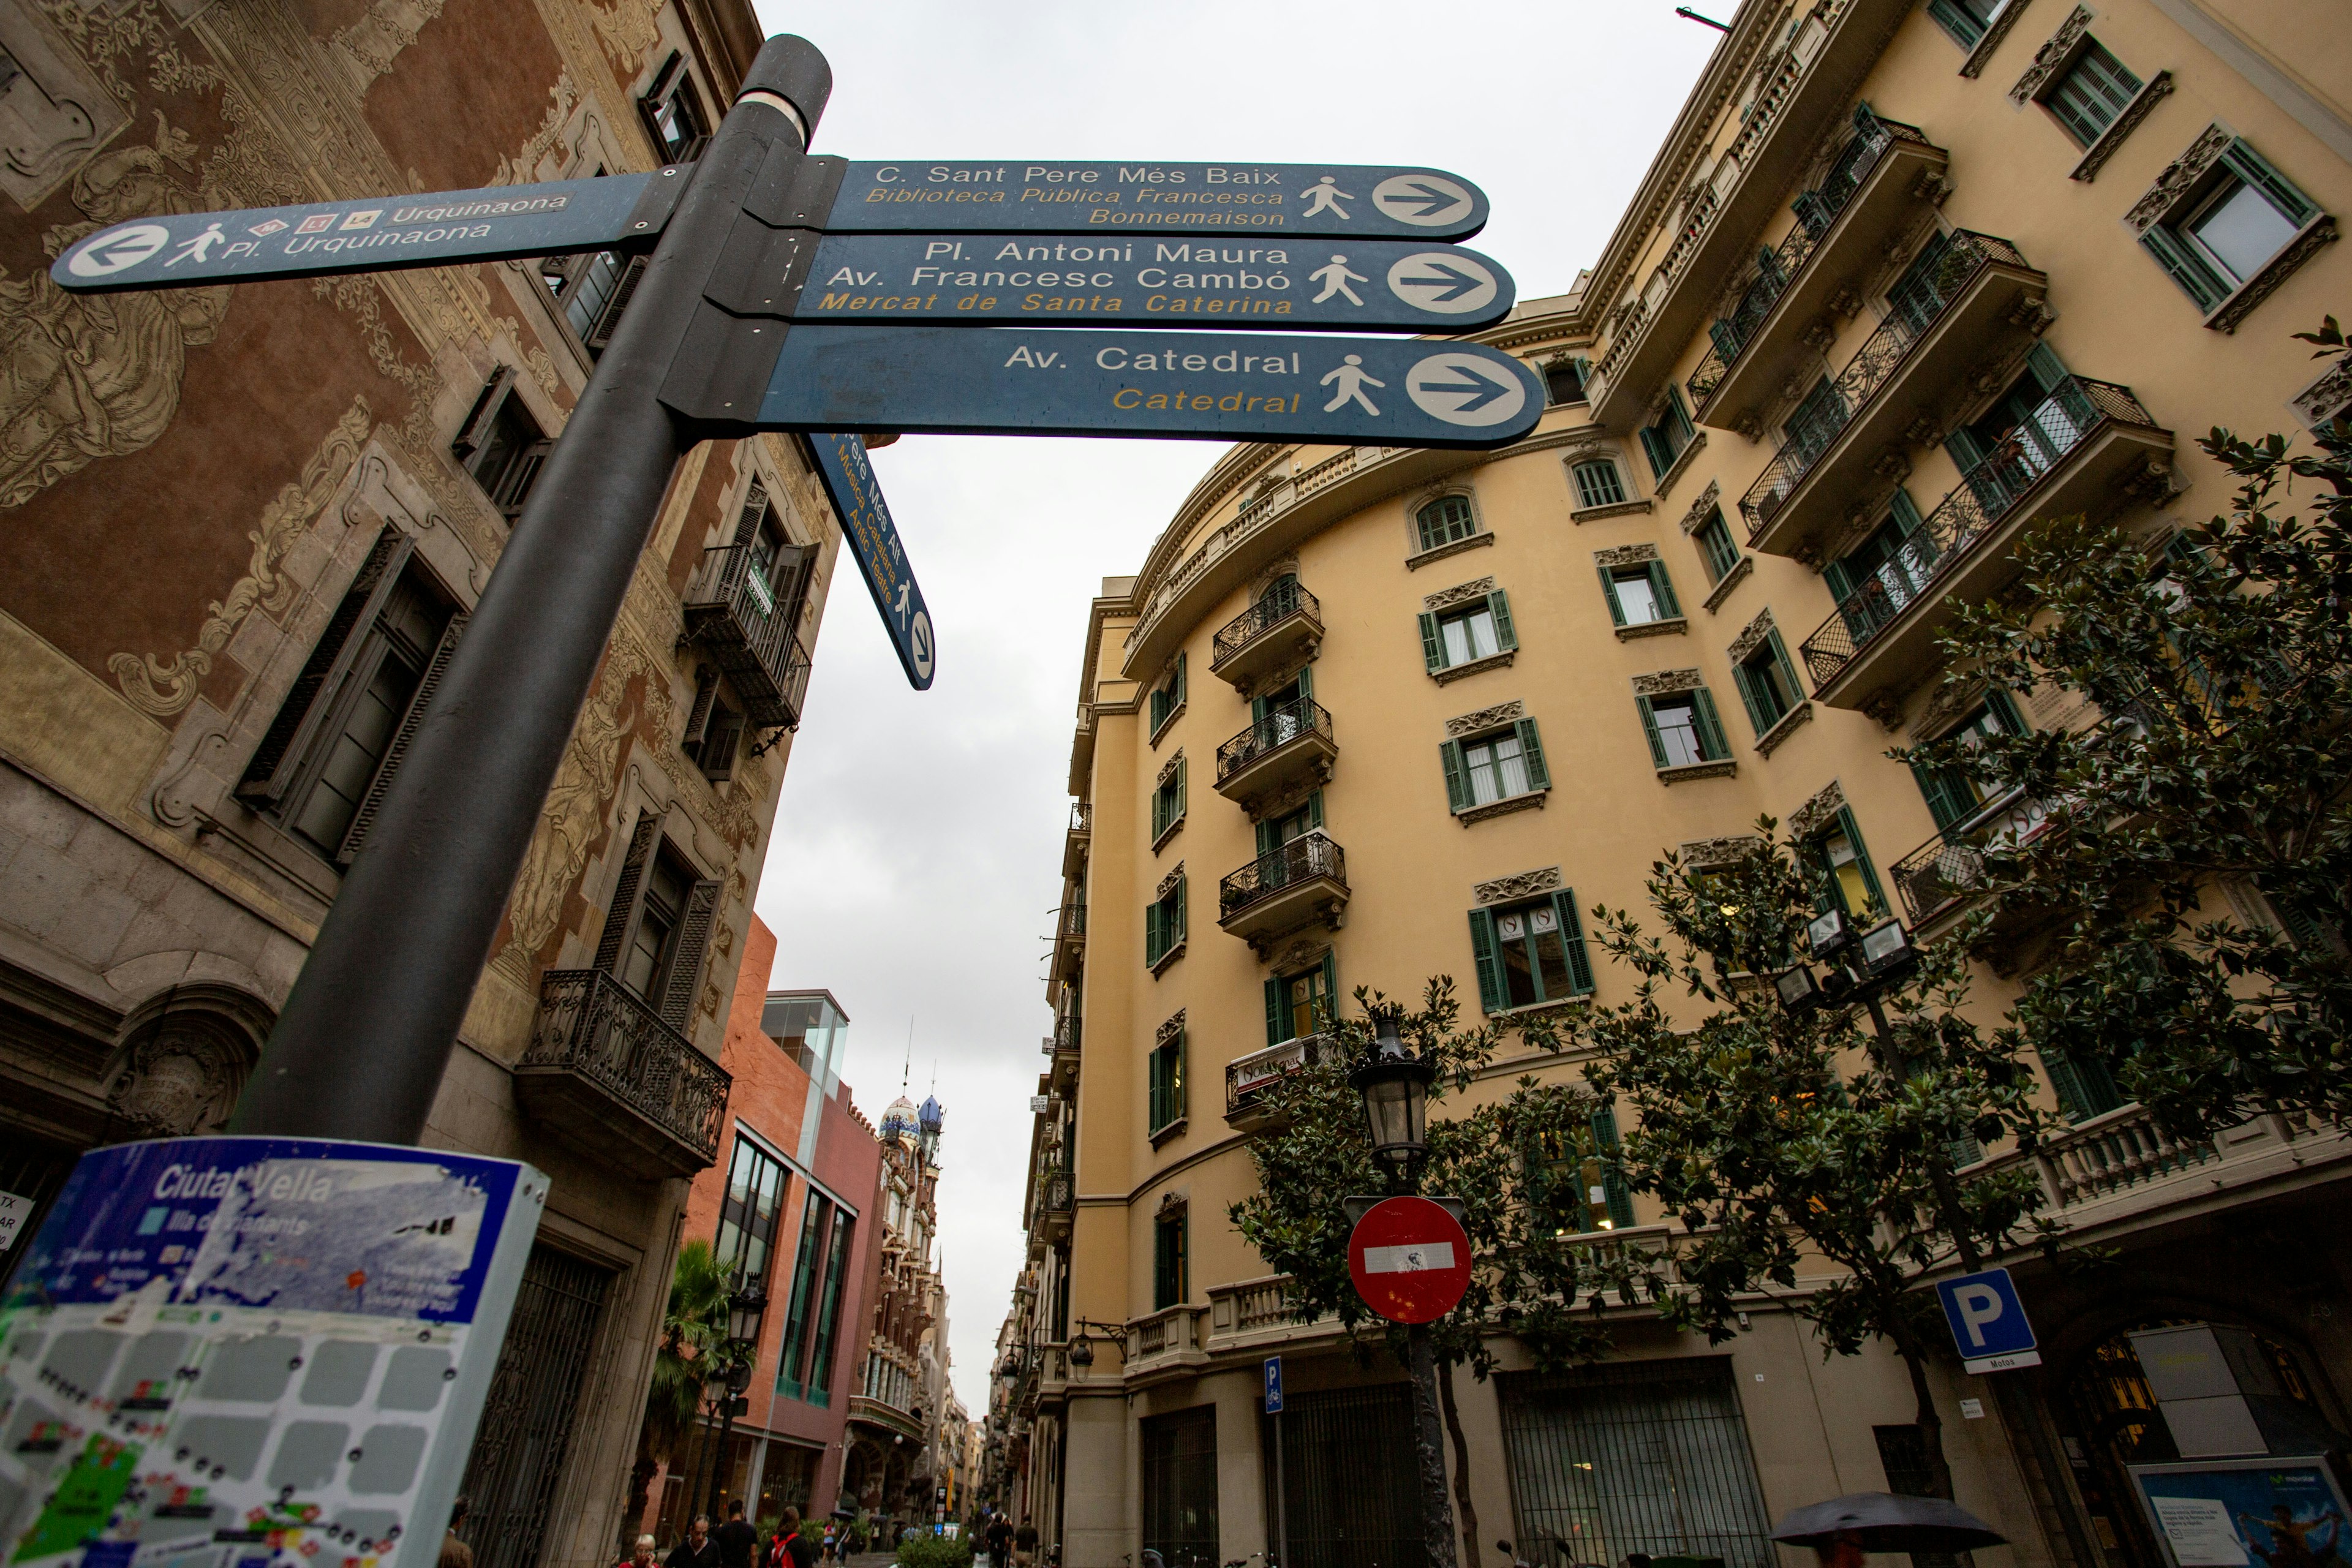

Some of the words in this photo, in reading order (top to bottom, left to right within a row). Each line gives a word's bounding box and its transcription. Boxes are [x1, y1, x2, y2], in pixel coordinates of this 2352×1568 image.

[876, 167, 906, 183] C.
[928, 166, 1006, 183] Sant
[1025, 167, 1099, 183] Pere
[1118, 167, 1186, 183] Més
[1207, 168, 1281, 184] Baix
[866, 188, 1005, 202] Biblioteca
[1020, 188, 1120, 203] Pública
[1136, 189, 1283, 205] Francesca
[393, 197, 568, 222] Urquinaona
[1089, 209, 1284, 225] Bonnemaison
[222, 241, 261, 259] Pl.
[284, 224, 491, 254] Urquinaona
[925, 242, 971, 260] Pl.
[995, 243, 1132, 262] Antoni
[1156, 244, 1289, 264] Maura
[827, 266, 883, 285] Av.
[912, 267, 1114, 287] Francesc
[1138, 268, 1291, 290] Cambó
[818, 293, 937, 310] Mercat
[957, 293, 997, 310] de
[1021, 293, 1122, 311] Santa
[1147, 295, 1292, 314] Caterina
[1005, 345, 1066, 369] Av.
[1096, 347, 1299, 374] Catedral
[1113, 388, 1300, 413] Catedral
[838, 444, 865, 511] Música
[867, 513, 896, 585] Catalana
[869, 481, 888, 532] Més
[888, 533, 900, 565] Alt
[850, 508, 870, 552] Antic
[870, 551, 892, 604] Teatre
[153, 1164, 246, 1201] Ciutat
[252, 1165, 331, 1203] Vella
[1952, 1283, 2003, 1348] P
[1269, 1366, 1276, 1385] P
[1990, 1359, 2015, 1368] Motos
